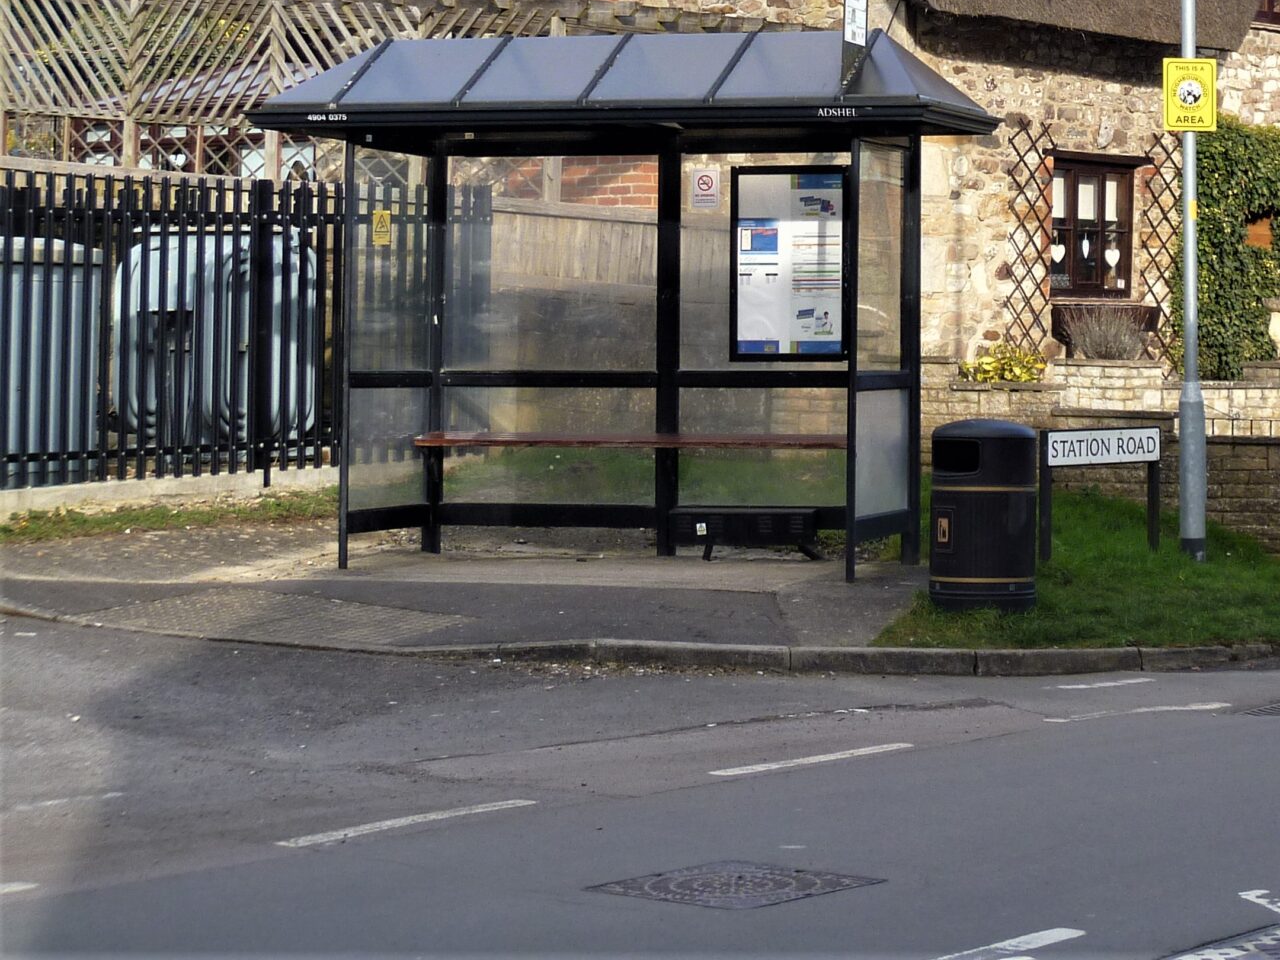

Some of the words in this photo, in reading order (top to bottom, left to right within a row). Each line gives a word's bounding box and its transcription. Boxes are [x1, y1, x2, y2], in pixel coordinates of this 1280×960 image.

[817, 107, 858, 117] ADSHEL
[1180, 103, 1201, 112] WATCH
[307, 113, 327, 121] 4904
[328, 113, 348, 121] 0375
[1175, 115, 1205, 124] AREA
[1051, 437, 1111, 459] STATION
[1116, 435, 1157, 456] ROAD
